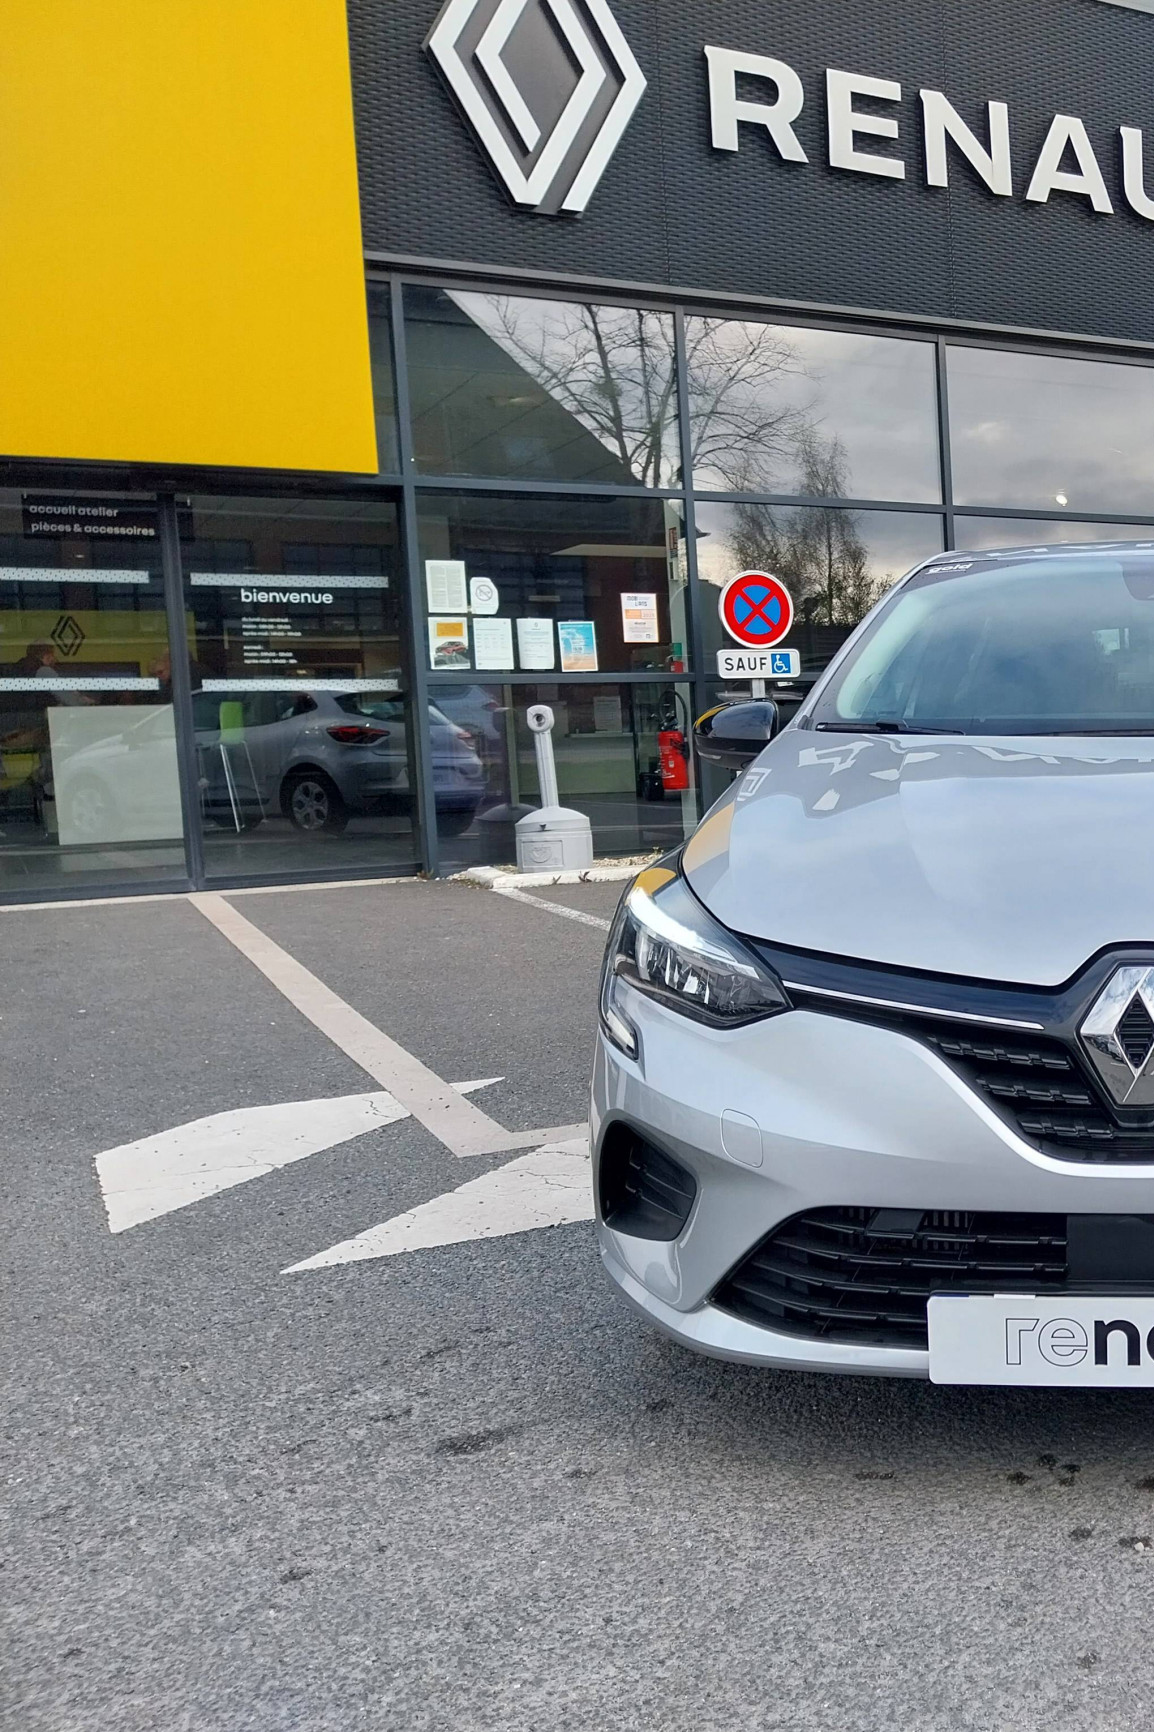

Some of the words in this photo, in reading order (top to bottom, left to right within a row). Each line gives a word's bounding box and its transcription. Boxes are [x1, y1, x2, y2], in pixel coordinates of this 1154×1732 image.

[29, 505, 76, 515] accueil
[78, 506, 119, 517] atelier
[31, 521, 72, 533] pièces
[73, 523, 83, 533] &
[84, 525, 156, 536] accessoires
[240, 588, 334, 604] bienvenue
[724, 657, 767, 671] SAUF
